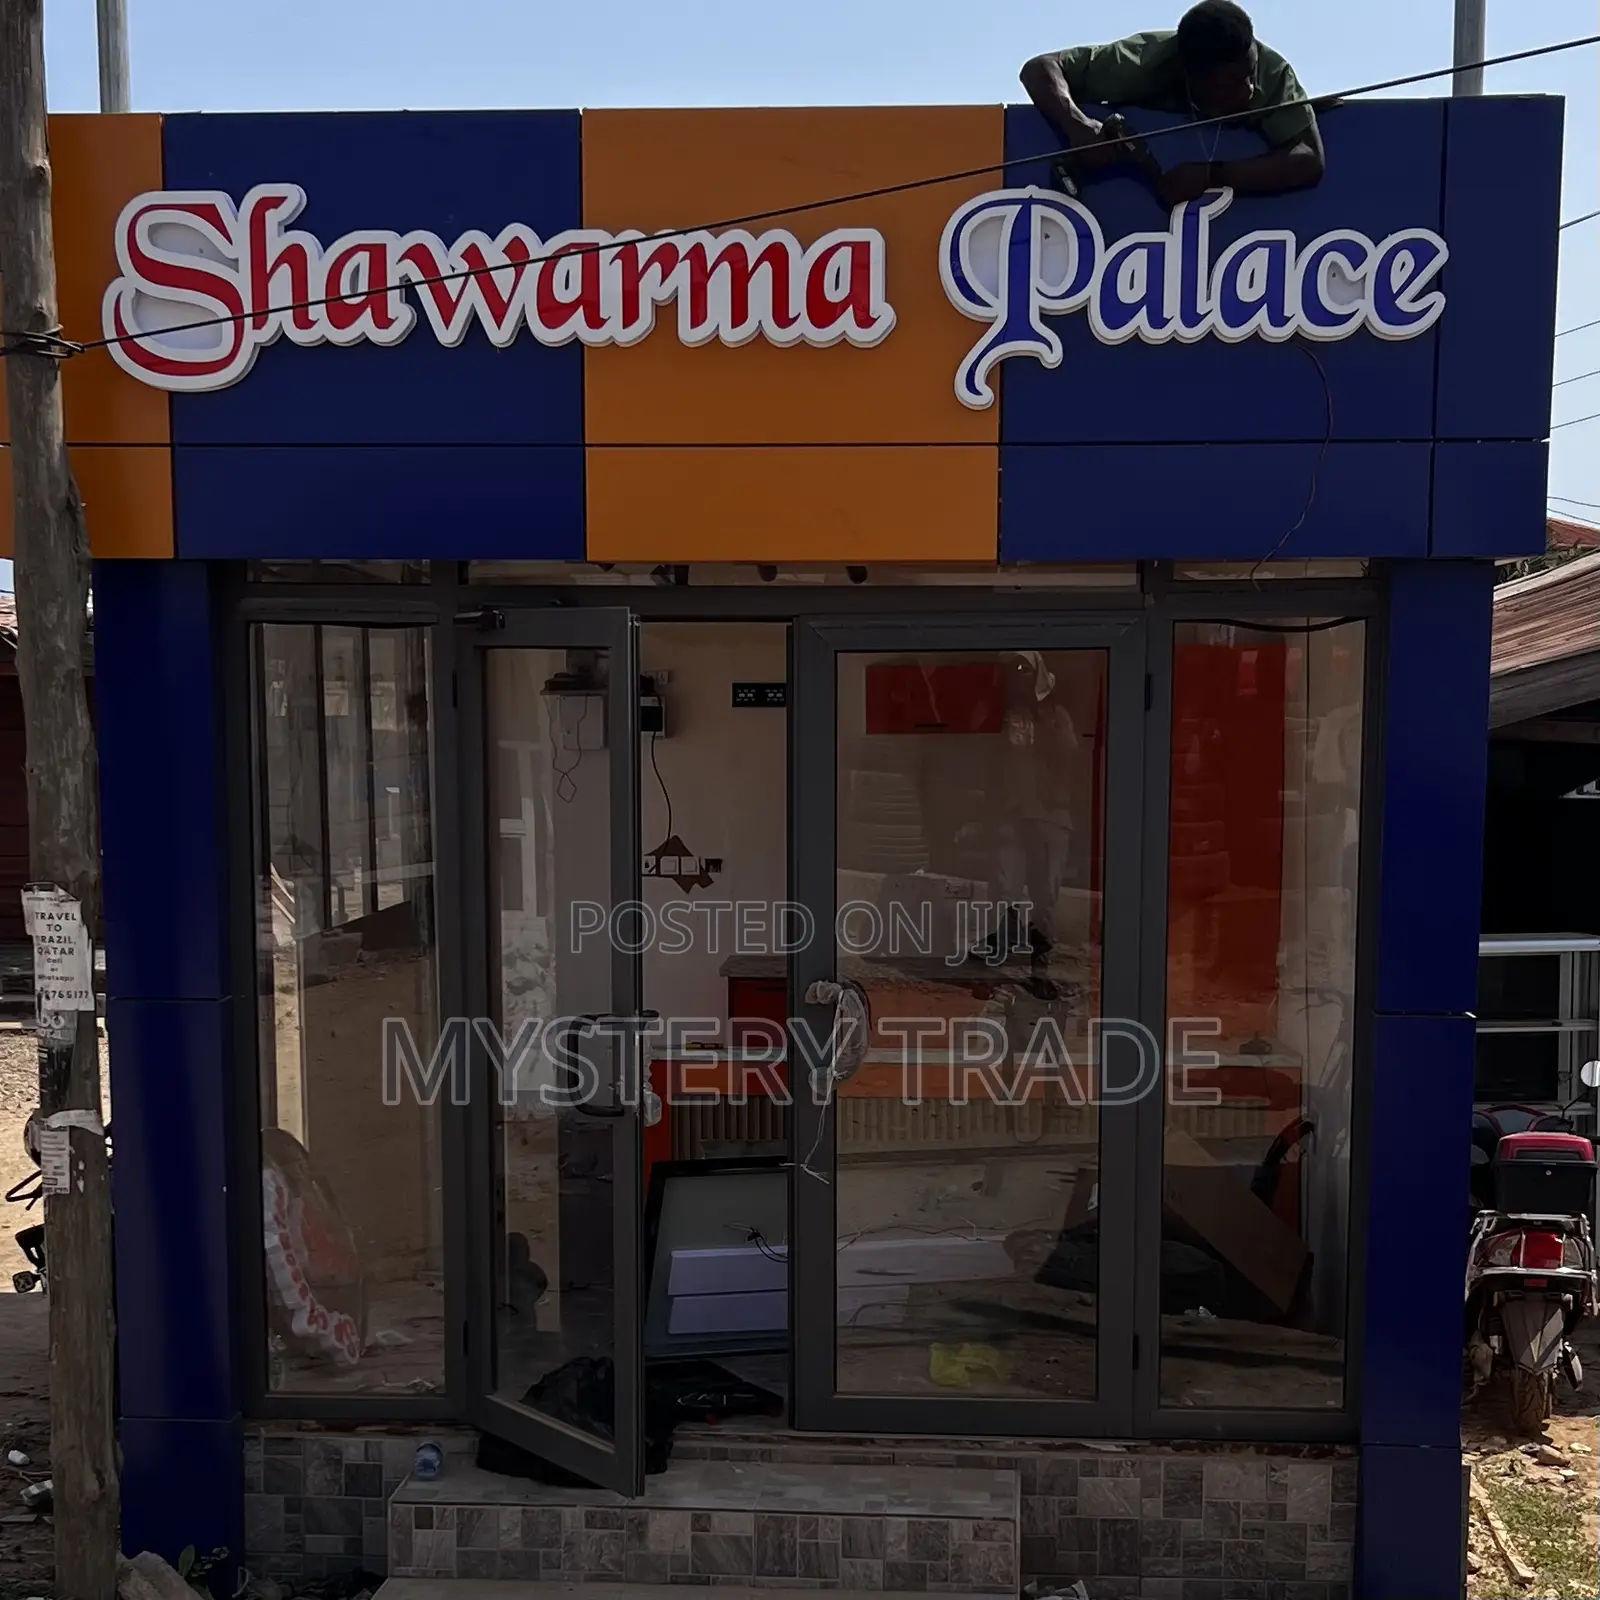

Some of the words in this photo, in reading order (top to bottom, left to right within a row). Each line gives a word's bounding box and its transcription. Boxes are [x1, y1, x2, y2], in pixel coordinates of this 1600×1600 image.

[101, 183, 896, 391] Shawarma
[938, 185, 1449, 410] Palace
[35, 912, 77, 921] TRAVEL
[46, 924, 62, 932] TO
[37, 946, 75, 956] QATAR
